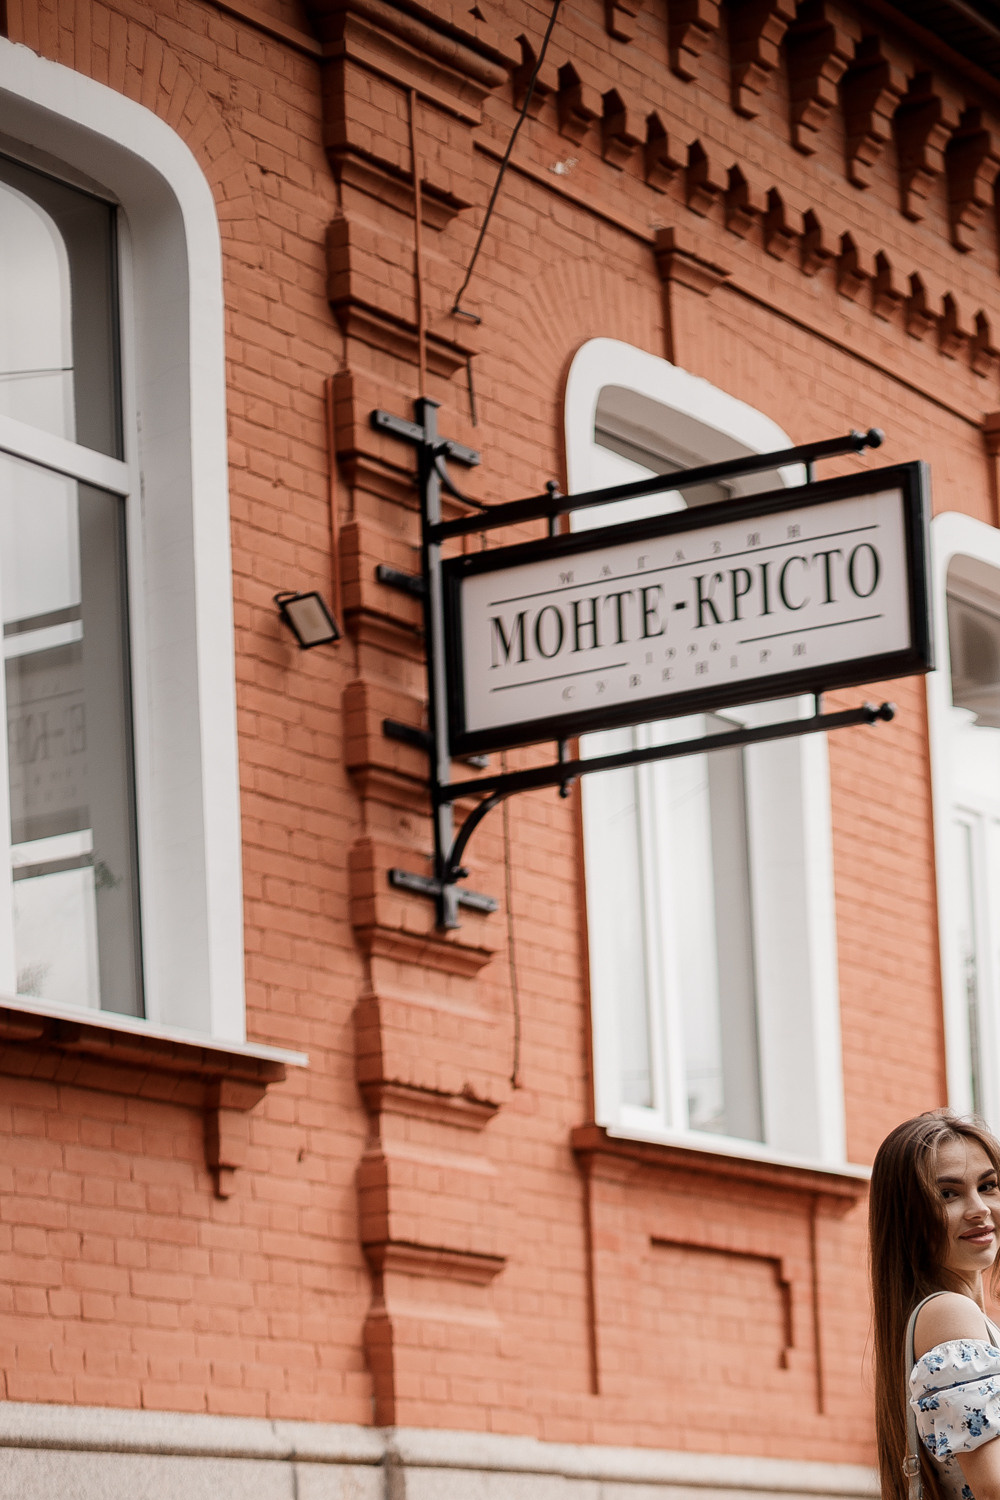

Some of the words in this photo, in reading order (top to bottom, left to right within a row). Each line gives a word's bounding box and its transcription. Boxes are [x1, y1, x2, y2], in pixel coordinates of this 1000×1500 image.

[558, 524, 801, 585] МАГАЗИН
[489, 542, 881, 669] МОНТЕ-КРІСТО
[562, 642, 807, 701] СУВЕНІРИ
[645, 639, 721, 665] 1996
